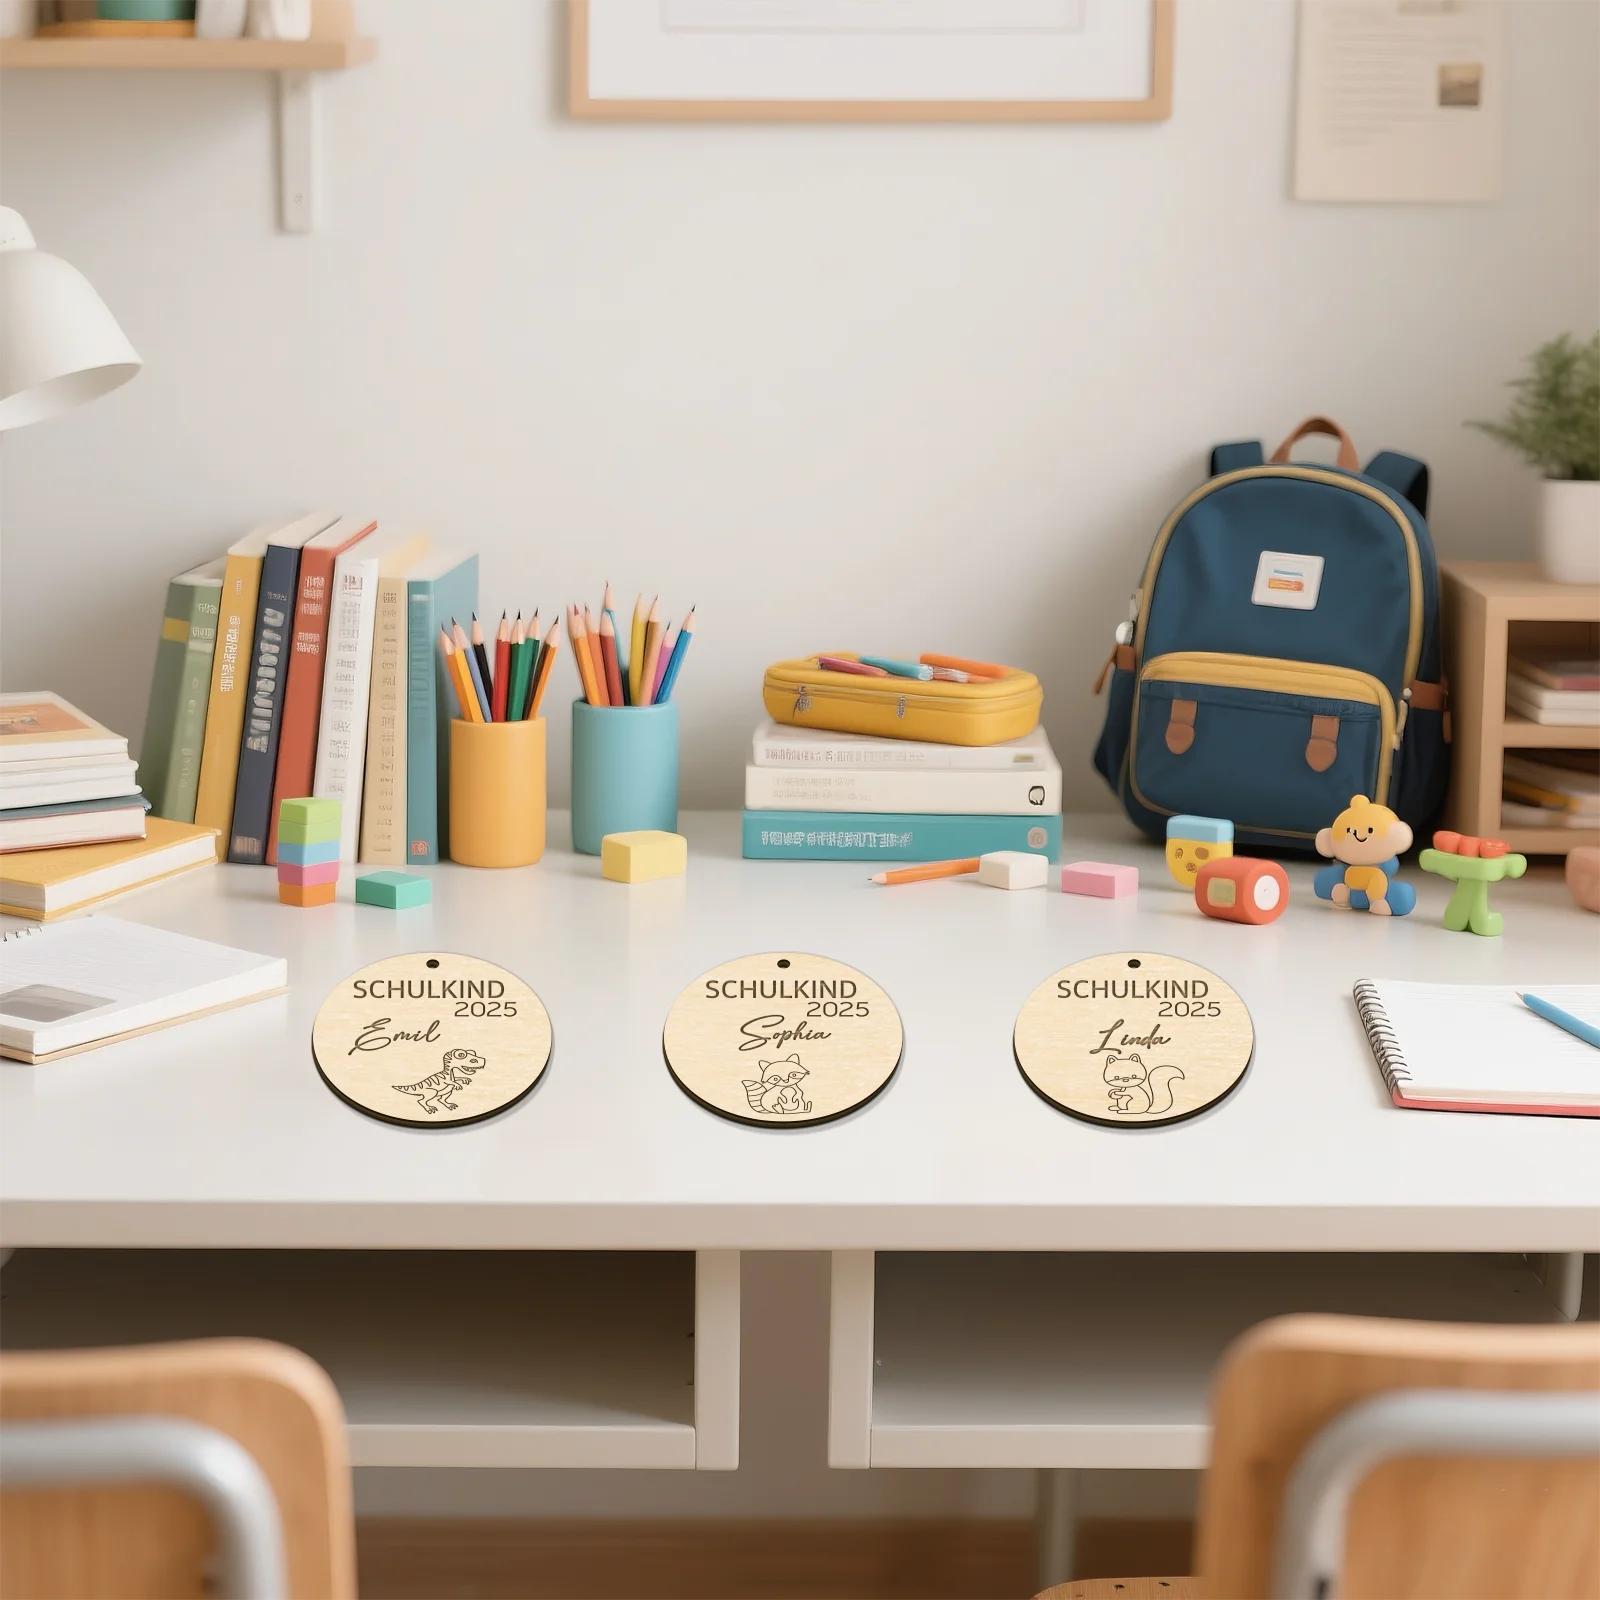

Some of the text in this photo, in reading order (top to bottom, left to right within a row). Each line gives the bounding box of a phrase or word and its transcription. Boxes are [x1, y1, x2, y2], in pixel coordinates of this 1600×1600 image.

[353, 980, 505, 999] SCHULKIND
[705, 980, 857, 999] SCHULKIND
[1057, 980, 1209, 999] SCHULKIND
[454, 1001, 518, 1017] 2025
[806, 1001, 870, 1017] 2025
[1158, 1001, 1221, 1017] 2025
[347, 1017, 441, 1056] Emil
[738, 1014, 832, 1051] Sophia
[1089, 1018, 1171, 1055] Linda
